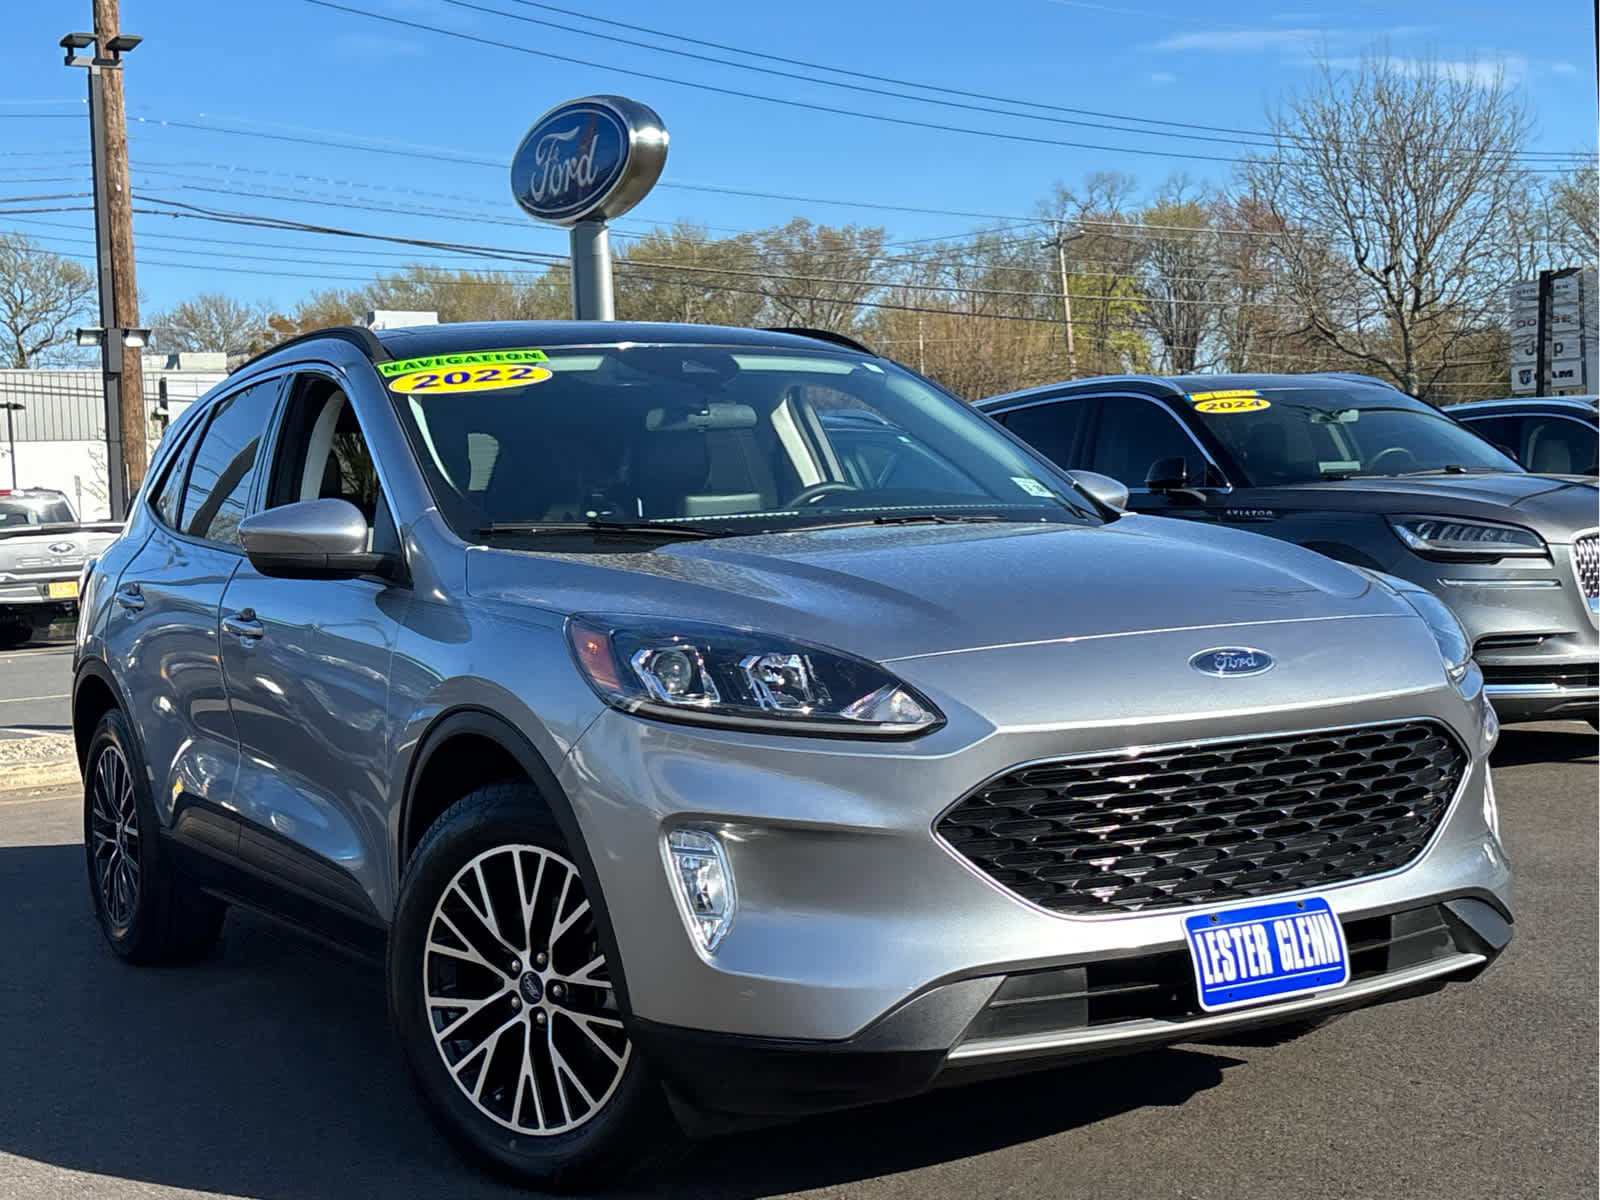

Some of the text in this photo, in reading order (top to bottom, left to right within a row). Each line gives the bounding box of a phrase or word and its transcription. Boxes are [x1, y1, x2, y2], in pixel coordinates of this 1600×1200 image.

[530, 126, 600, 202] Ford
[1525, 340, 1564, 357] Jp
[383, 352, 542, 374] NAVIGATION
[412, 367, 535, 390] 2022
[1534, 369, 1574, 381] AM
[1205, 400, 1262, 411] 2024
[1214, 652, 1257, 671] Ford
[1194, 912, 1341, 985] LESTER GLENN
